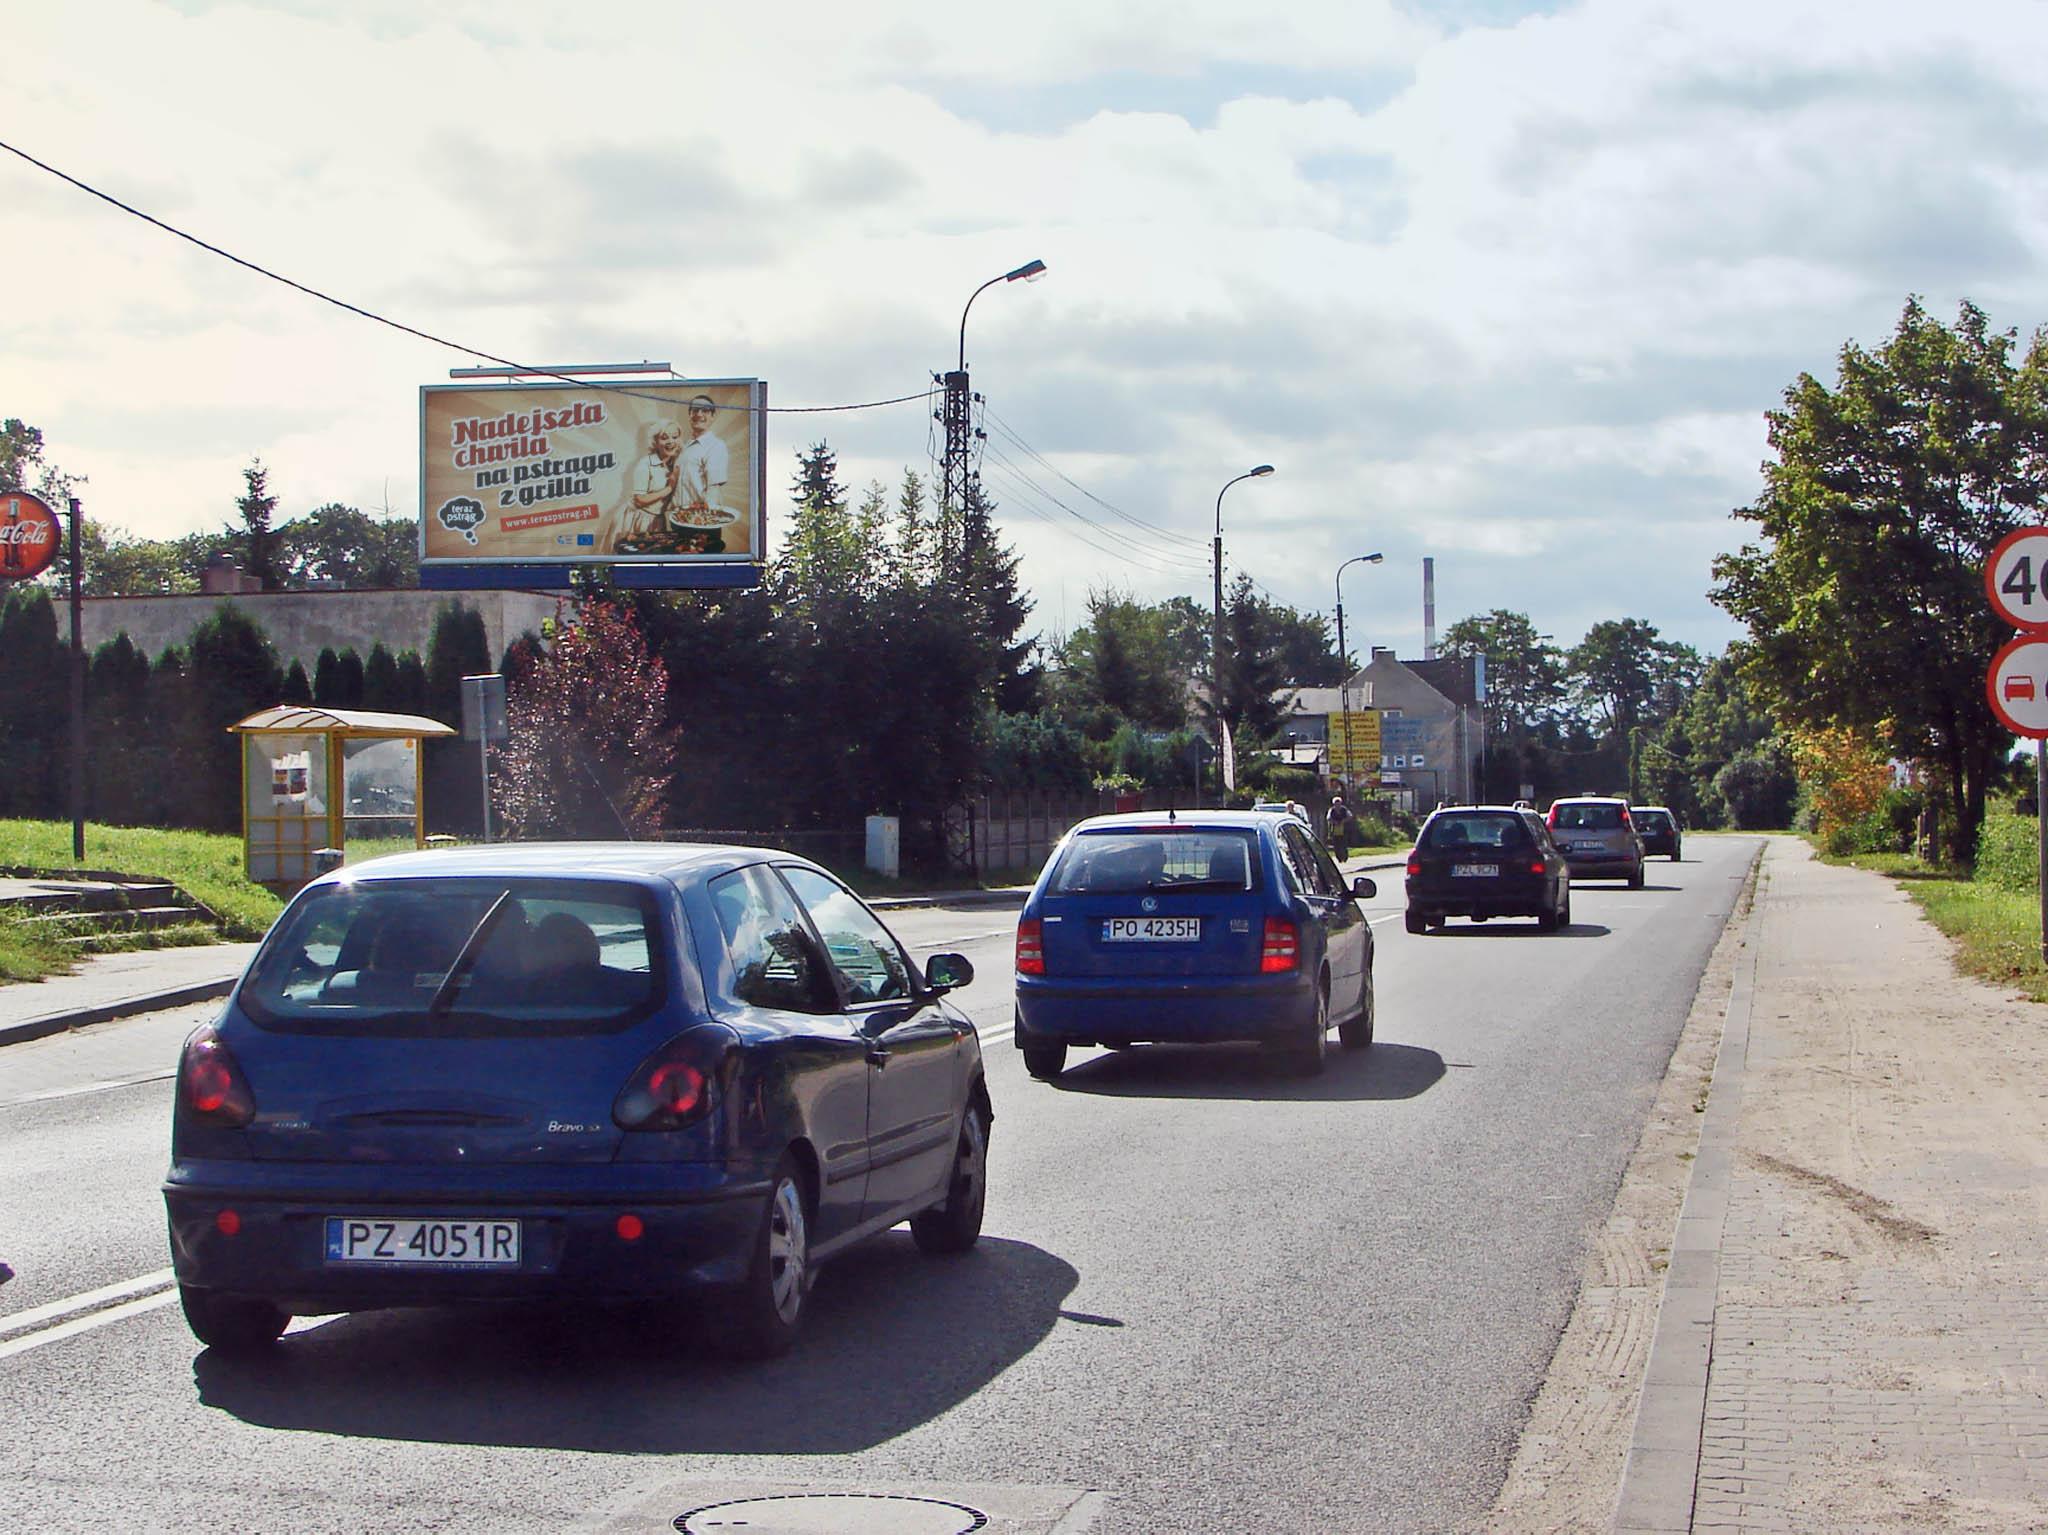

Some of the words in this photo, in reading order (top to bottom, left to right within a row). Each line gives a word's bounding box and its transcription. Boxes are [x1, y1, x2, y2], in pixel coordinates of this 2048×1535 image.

[453, 402, 606, 445] Nadejszła
[455, 436, 550, 467] chwila
[476, 468, 510, 488] na
[500, 489, 516, 506] z
[518, 477, 593, 506] grilla
[451, 505, 473, 513] teraz
[2002, 556, 2048, 605] 4
[1112, 920, 1138, 937] PO
[1144, 920, 1198, 937] 4235H
[548, 1120, 584, 1132] Bravo
[348, 1223, 396, 1257] PZ
[408, 1224, 513, 1259] 4051R
